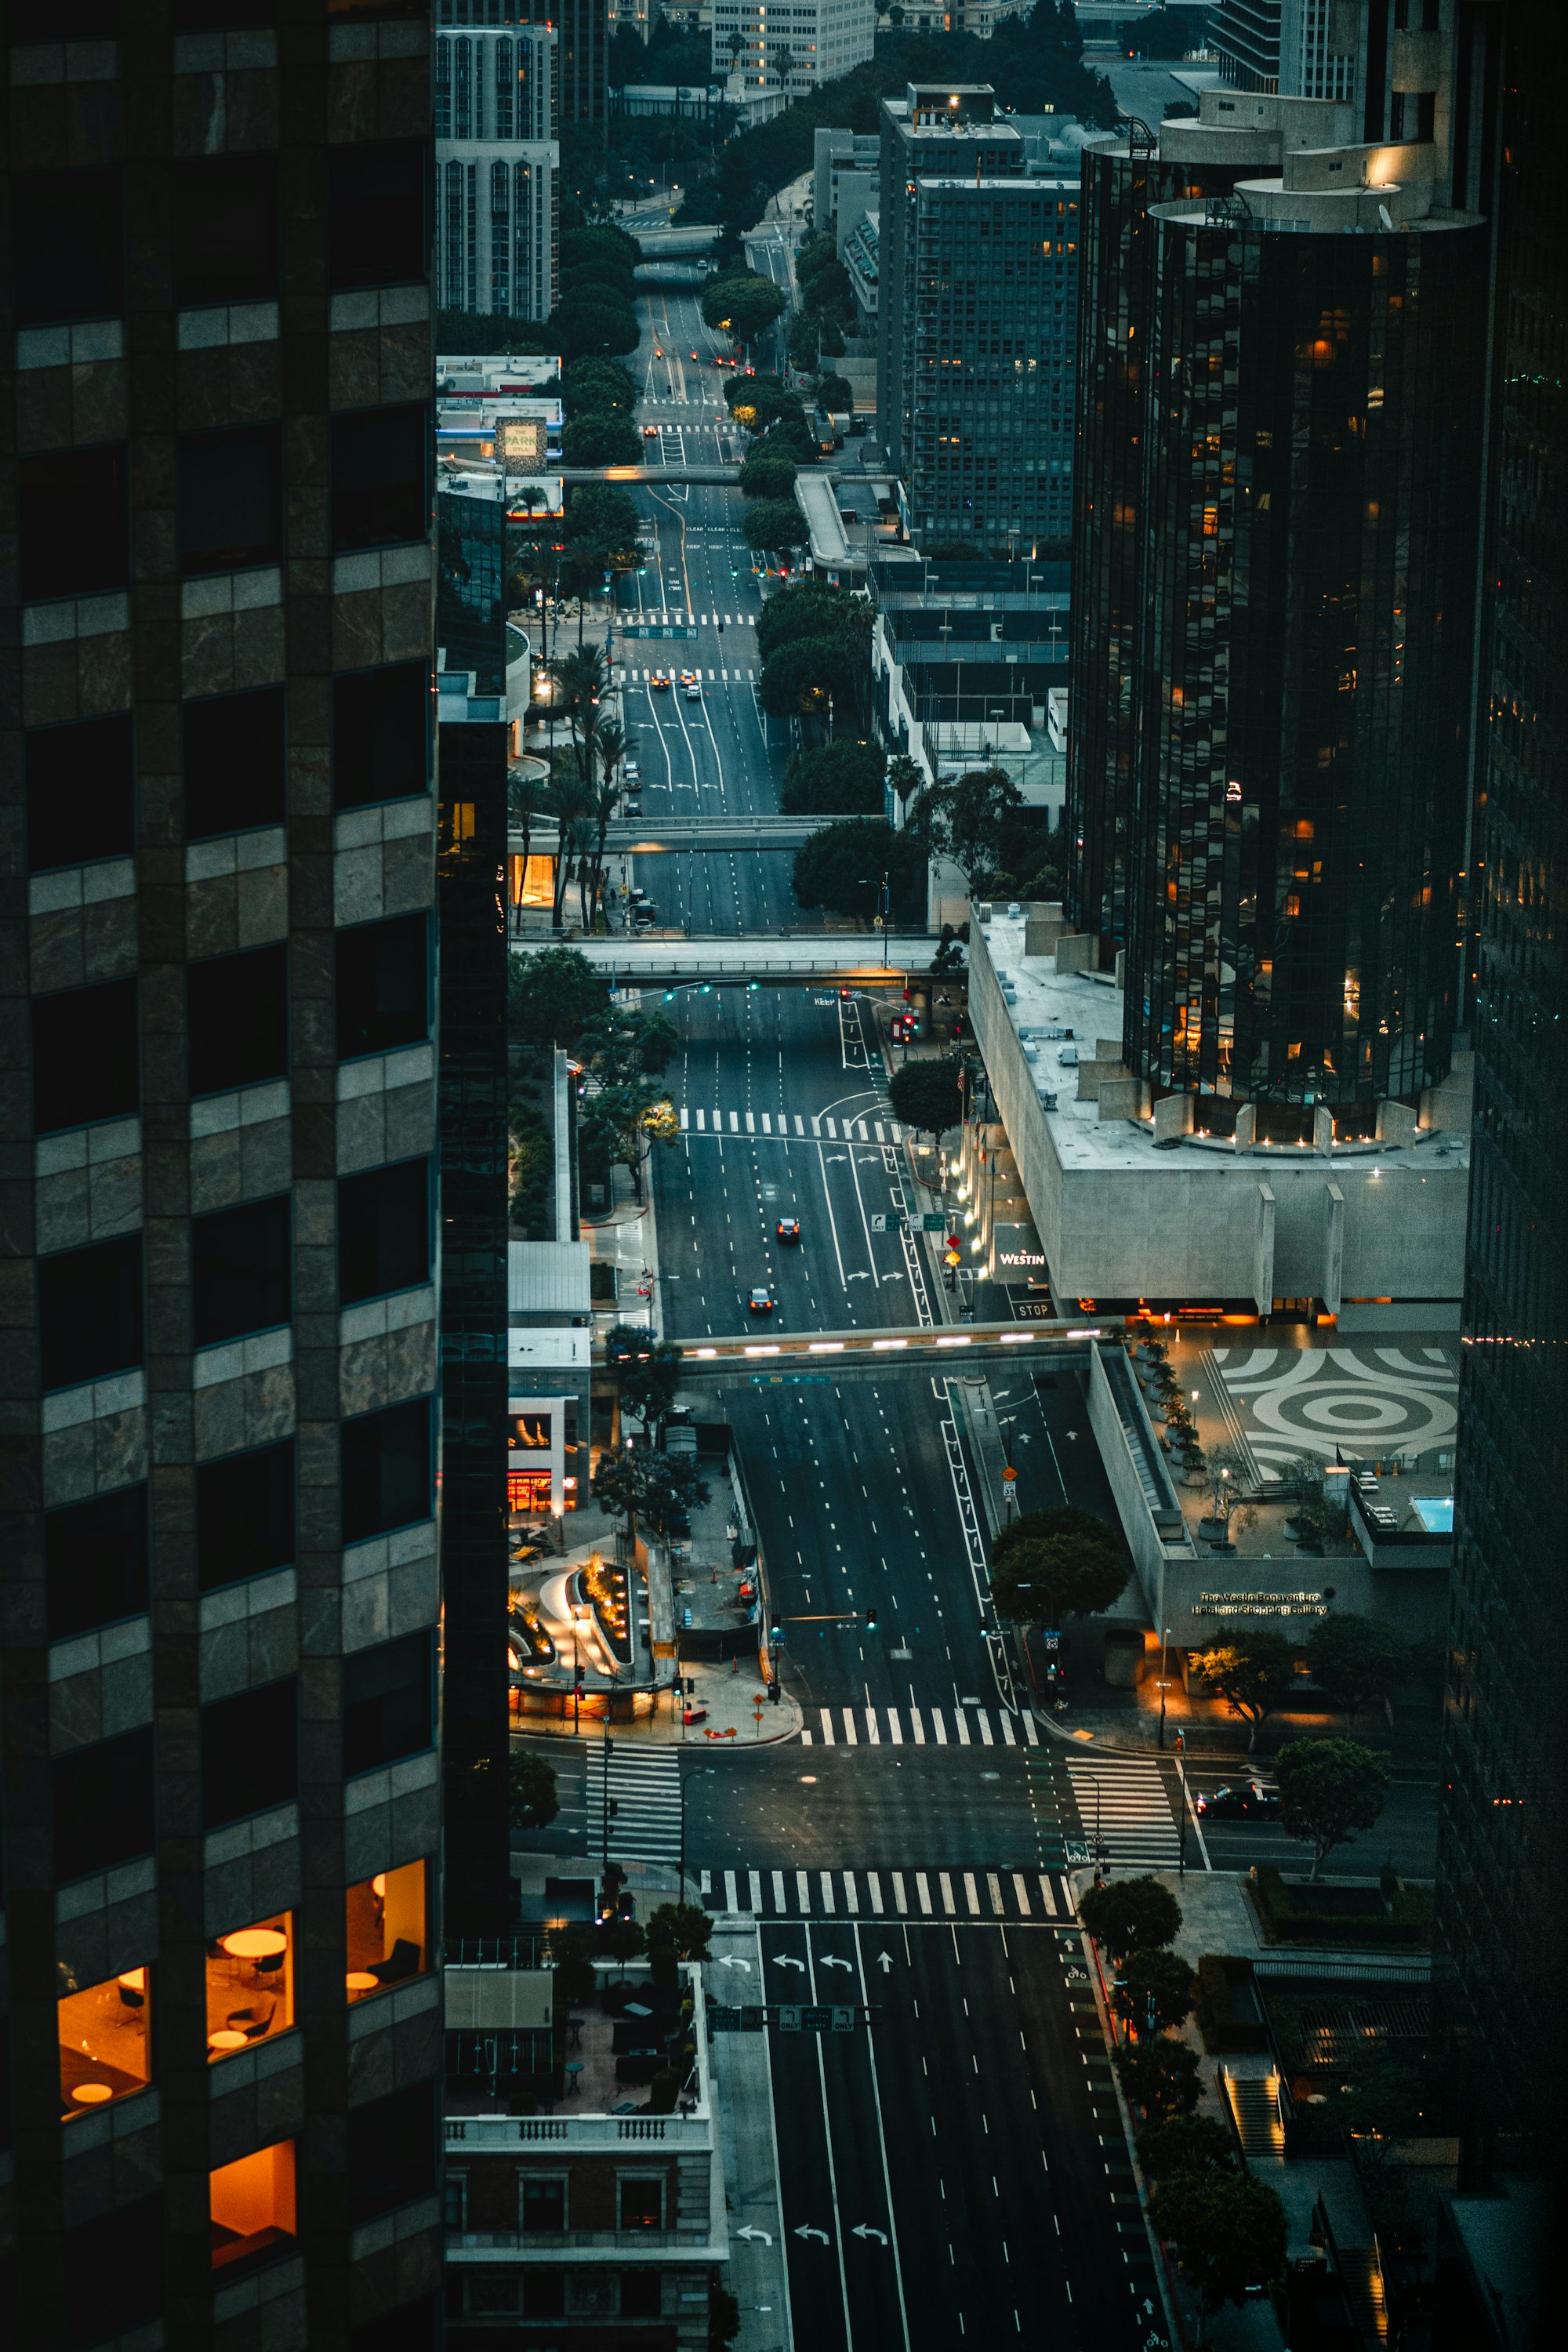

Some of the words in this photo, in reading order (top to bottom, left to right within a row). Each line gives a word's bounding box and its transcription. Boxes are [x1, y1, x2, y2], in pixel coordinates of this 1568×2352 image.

[504, 436, 537, 445] PARK
[1019, 1305, 1048, 1316] STOP
[1202, 1592, 1220, 1602] The
[1223, 1592, 1255, 1602] Westin
[1257, 1592, 1321, 1602] Bonaventure
[1192, 1605, 1219, 1614] Hotel
[1221, 1605, 1240, 1614] and
[1240, 1605, 1289, 1616] Shopping
[1290, 1605, 1327, 1616] Gallery
